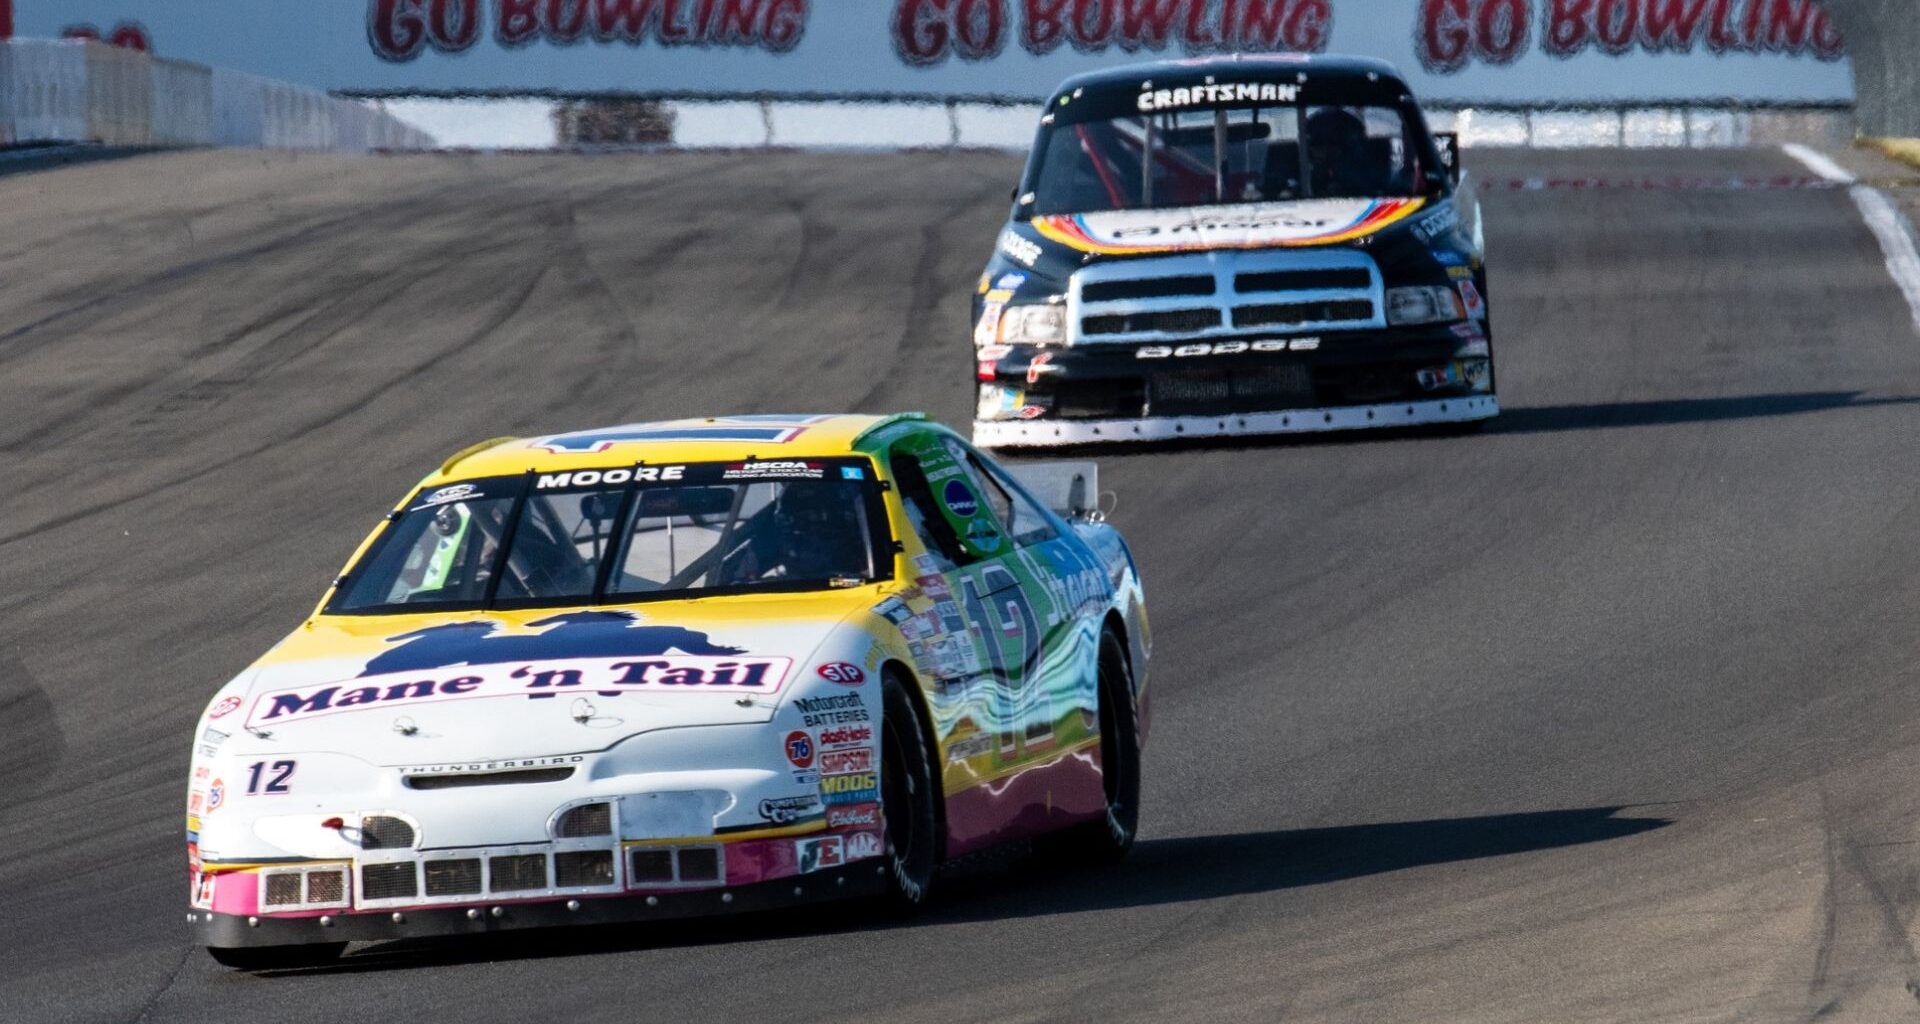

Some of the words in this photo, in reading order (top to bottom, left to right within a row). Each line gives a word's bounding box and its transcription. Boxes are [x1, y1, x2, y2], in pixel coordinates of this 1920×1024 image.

[370, 0, 480, 60] GO
[494, 0, 804, 50] BOWLING
[894, 0, 1004, 64] GO
[1020, 0, 1332, 54] BOWLING
[1418, 0, 1530, 72] GO
[1137, 83, 1299, 111] CRAFTSMAN
[1136, 336, 1321, 359] DODGE
[537, 465, 686, 489] MOORE
[743, 461, 809, 470] HSCRA
[822, 663, 860, 682] STP
[260, 675, 484, 720] Mane
[609, 660, 772, 687] Tail
[793, 691, 864, 713] Motorcraft
[803, 709, 869, 727] BATTERIES
[789, 737, 809, 759] 76
[398, 755, 584, 774] THUNDERBIRD
[821, 750, 870, 774] SIMPSON
[245, 760, 297, 795] 12
[822, 774, 876, 794] MOOG
[800, 839, 840, 873] JE
